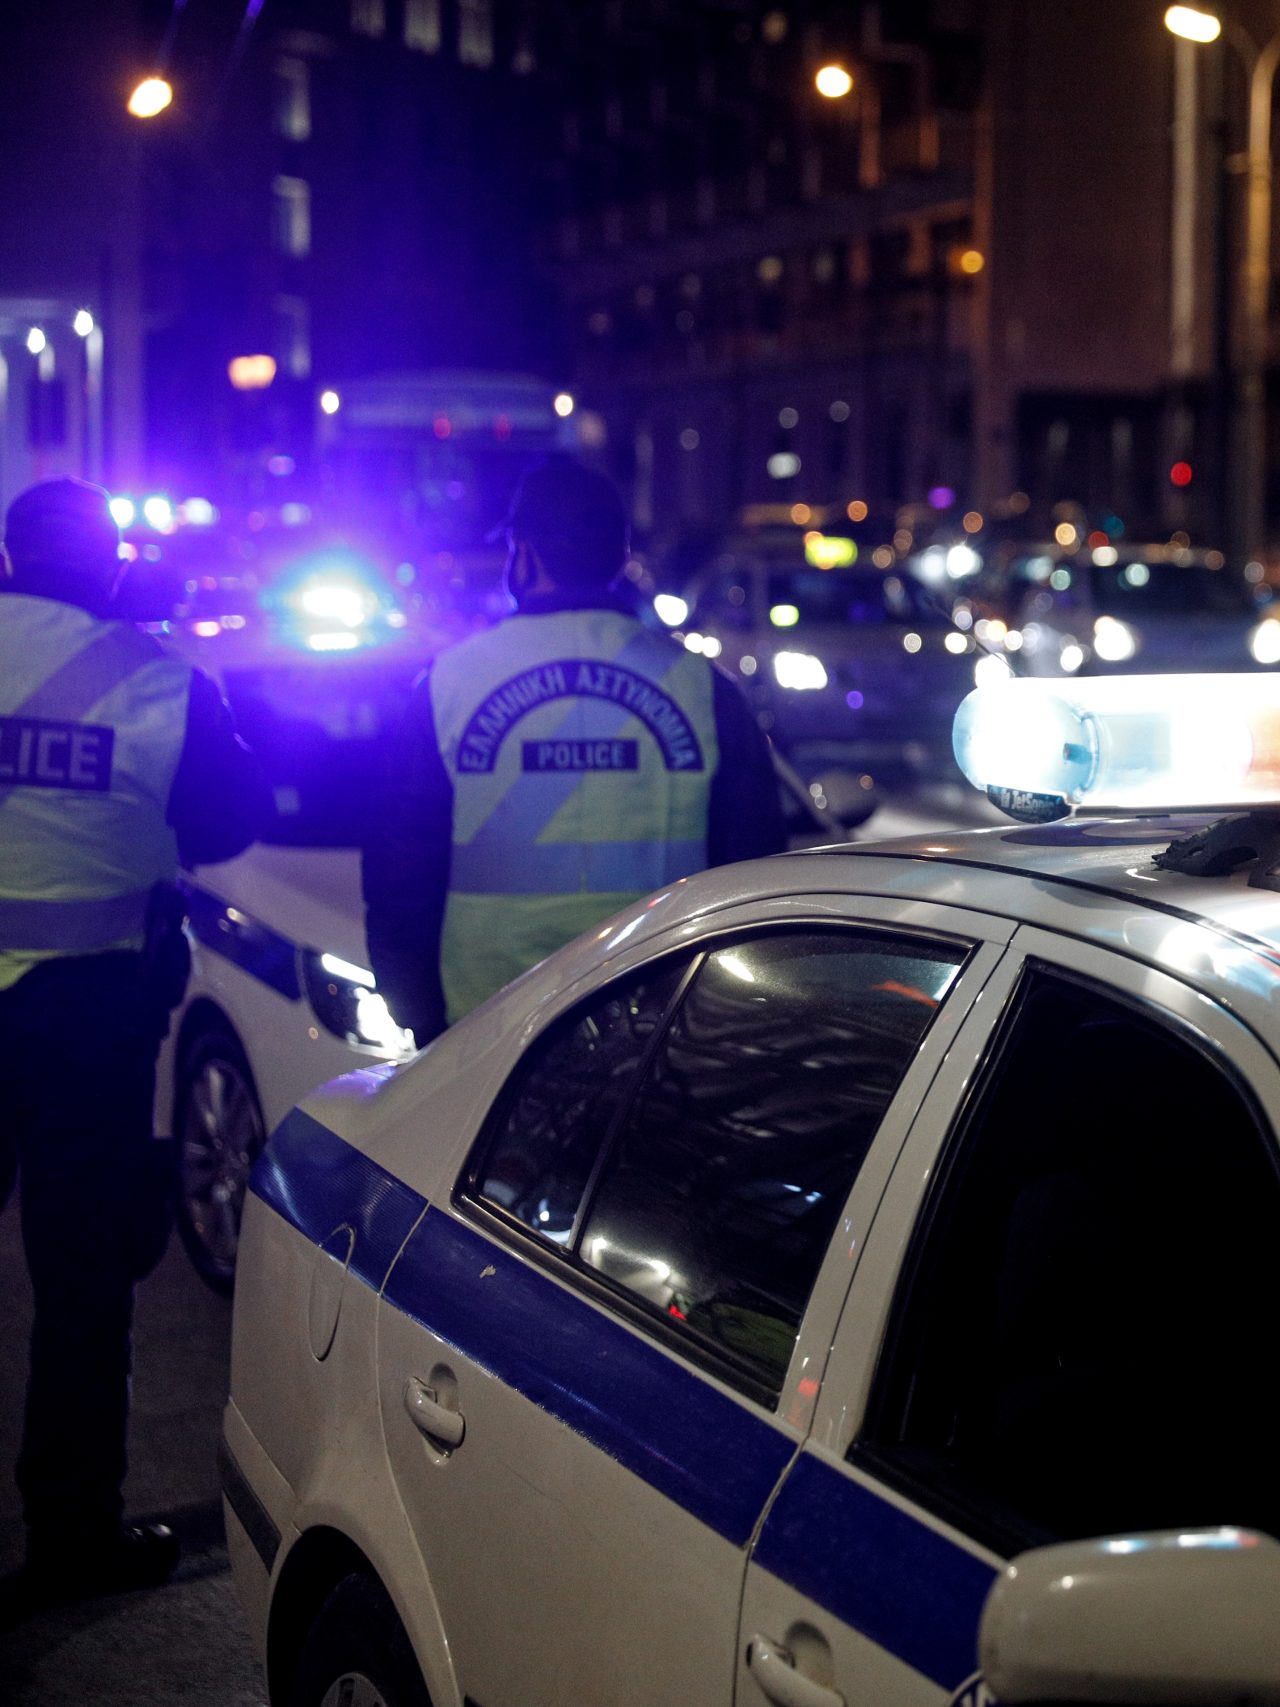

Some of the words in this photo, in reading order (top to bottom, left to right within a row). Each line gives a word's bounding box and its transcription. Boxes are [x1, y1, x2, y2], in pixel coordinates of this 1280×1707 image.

[461, 664, 567, 769] ΕΛΛΗΝΙΚΗ
[575, 663, 695, 768] ΑΣΤΥΝΟΜΙΑ
[538, 743, 624, 769] POLICE
